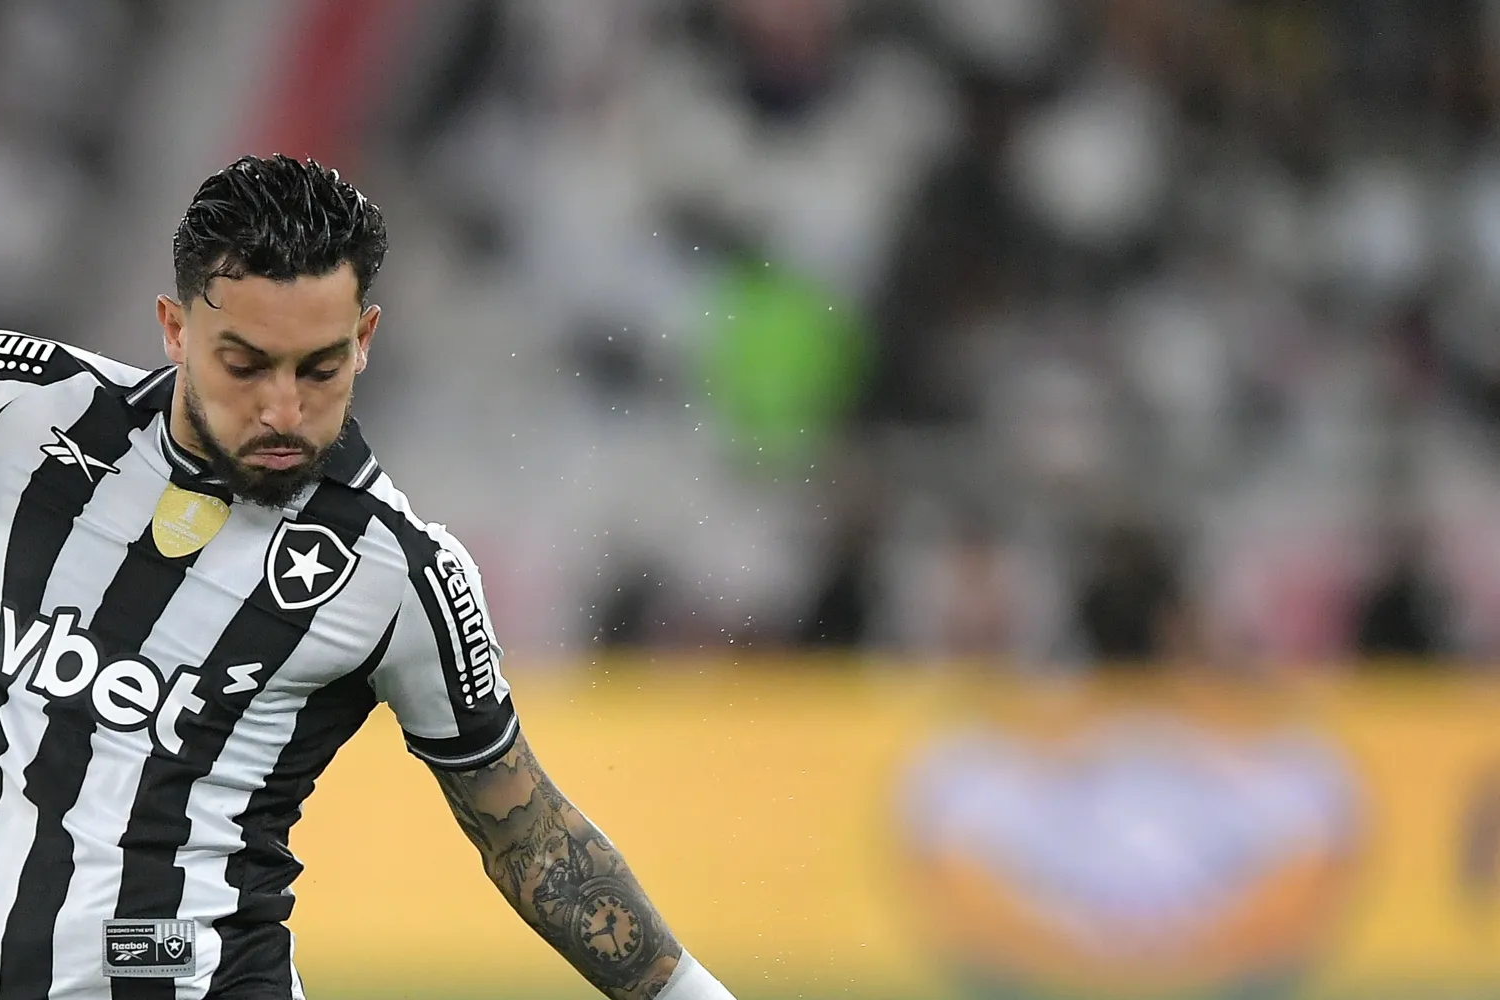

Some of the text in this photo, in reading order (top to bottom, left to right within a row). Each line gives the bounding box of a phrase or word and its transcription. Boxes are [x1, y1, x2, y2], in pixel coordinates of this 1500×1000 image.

[2, 606, 206, 755] vbet
[436, 549, 495, 700] centrum
[111, 942, 149, 951] Reebok
